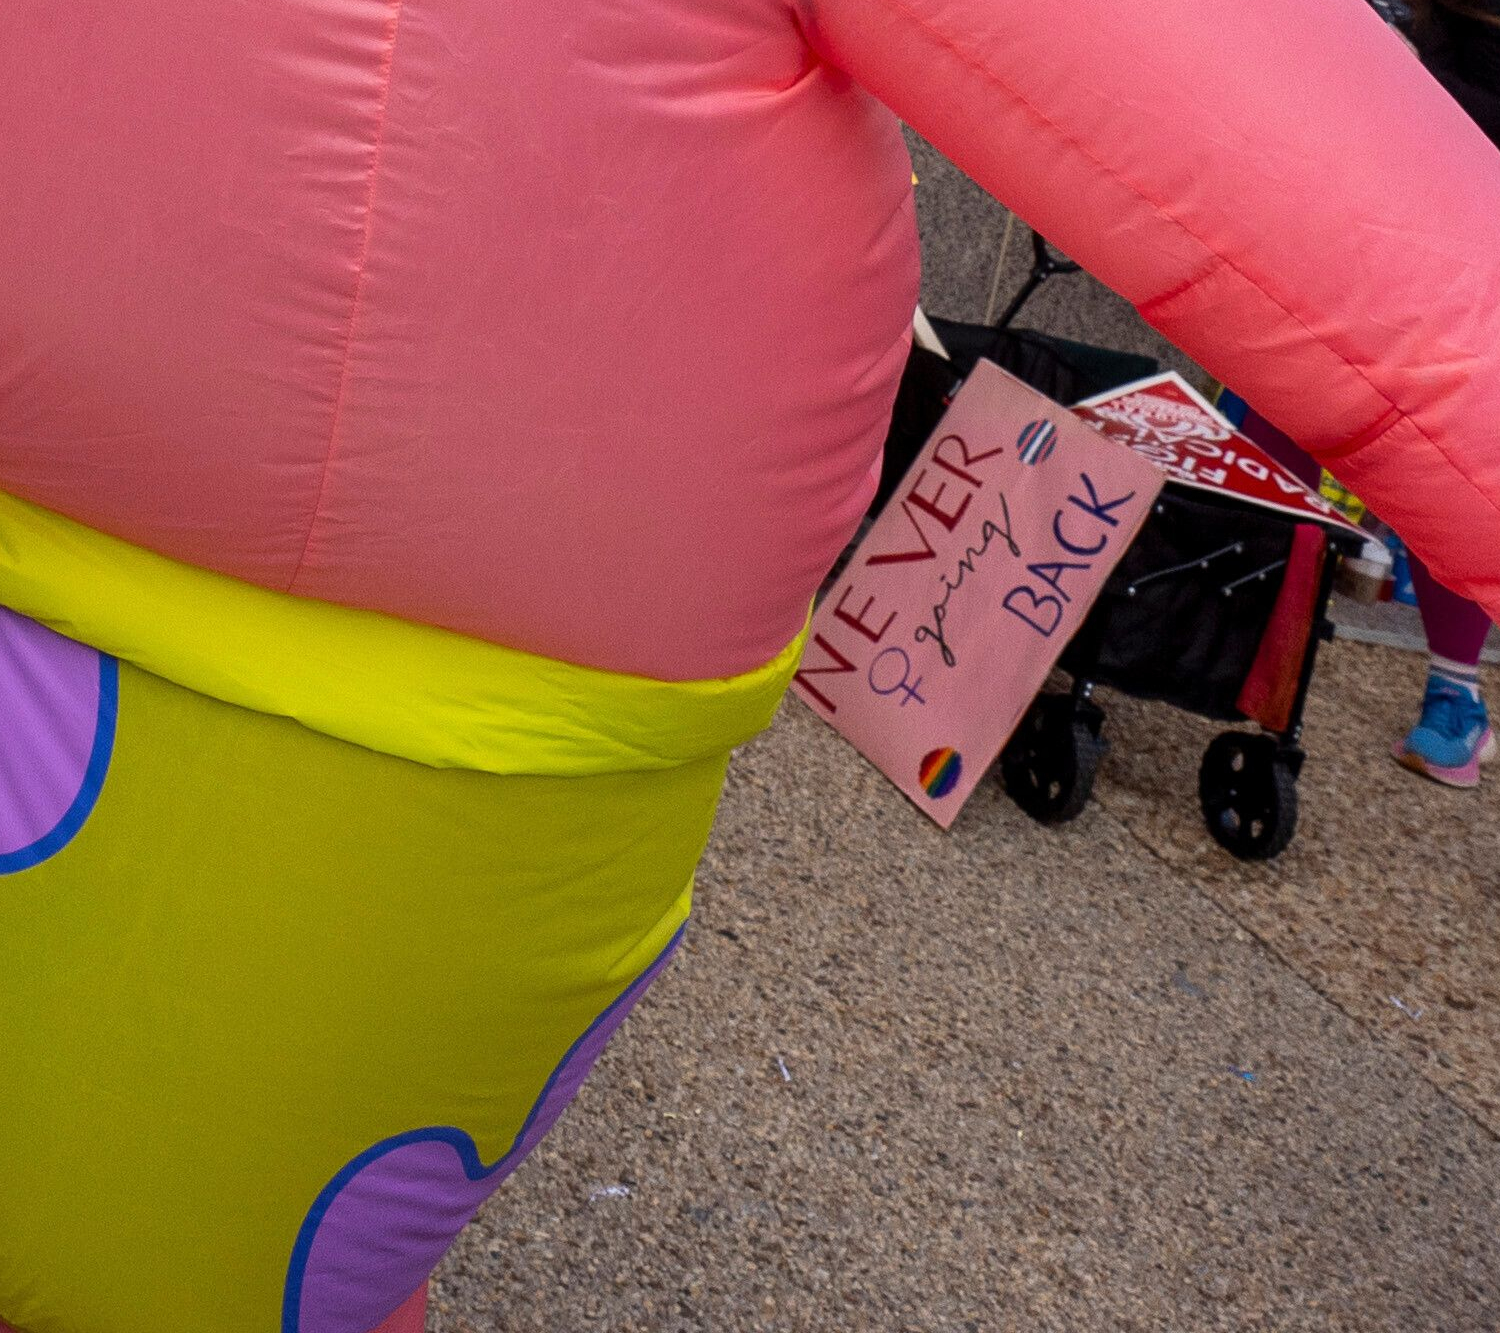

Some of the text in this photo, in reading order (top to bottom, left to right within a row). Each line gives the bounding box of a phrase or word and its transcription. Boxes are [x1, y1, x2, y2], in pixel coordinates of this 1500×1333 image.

[792, 434, 1003, 714] NEVER
[914, 492, 1021, 667] going
[1002, 472, 1136, 638] BACK
